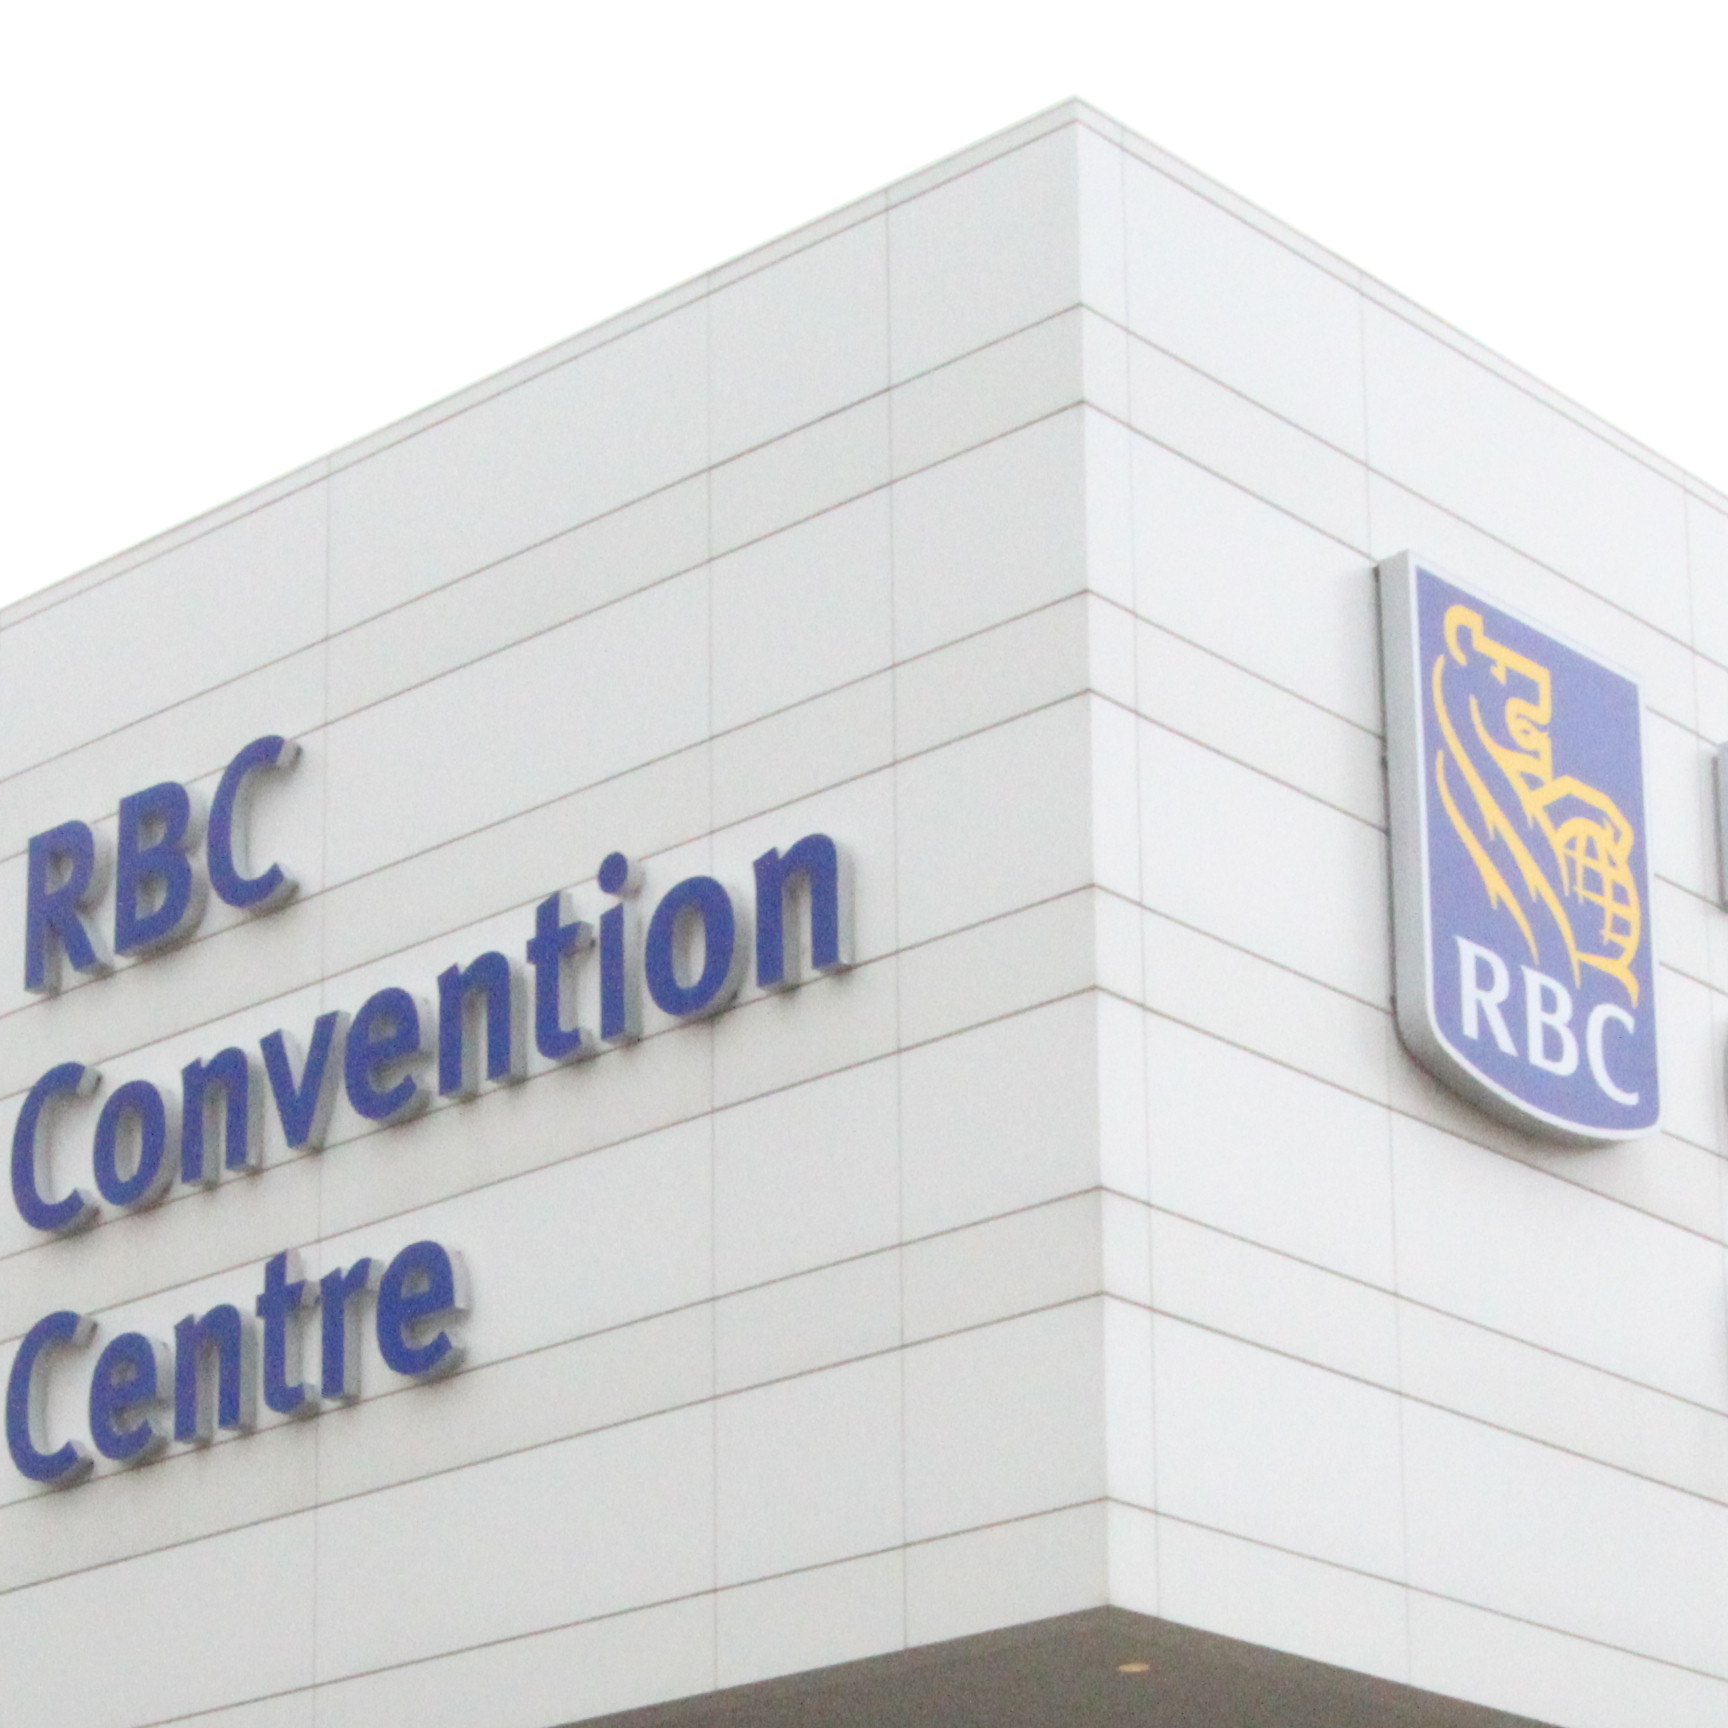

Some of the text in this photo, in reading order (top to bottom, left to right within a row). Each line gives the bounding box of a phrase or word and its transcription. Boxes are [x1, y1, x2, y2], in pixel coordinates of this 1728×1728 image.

[25, 734, 300, 995] RBC
[10, 832, 846, 1235] Convention
[1455, 935, 1640, 1107] RBC
[5, 1238, 467, 1486] Centre
